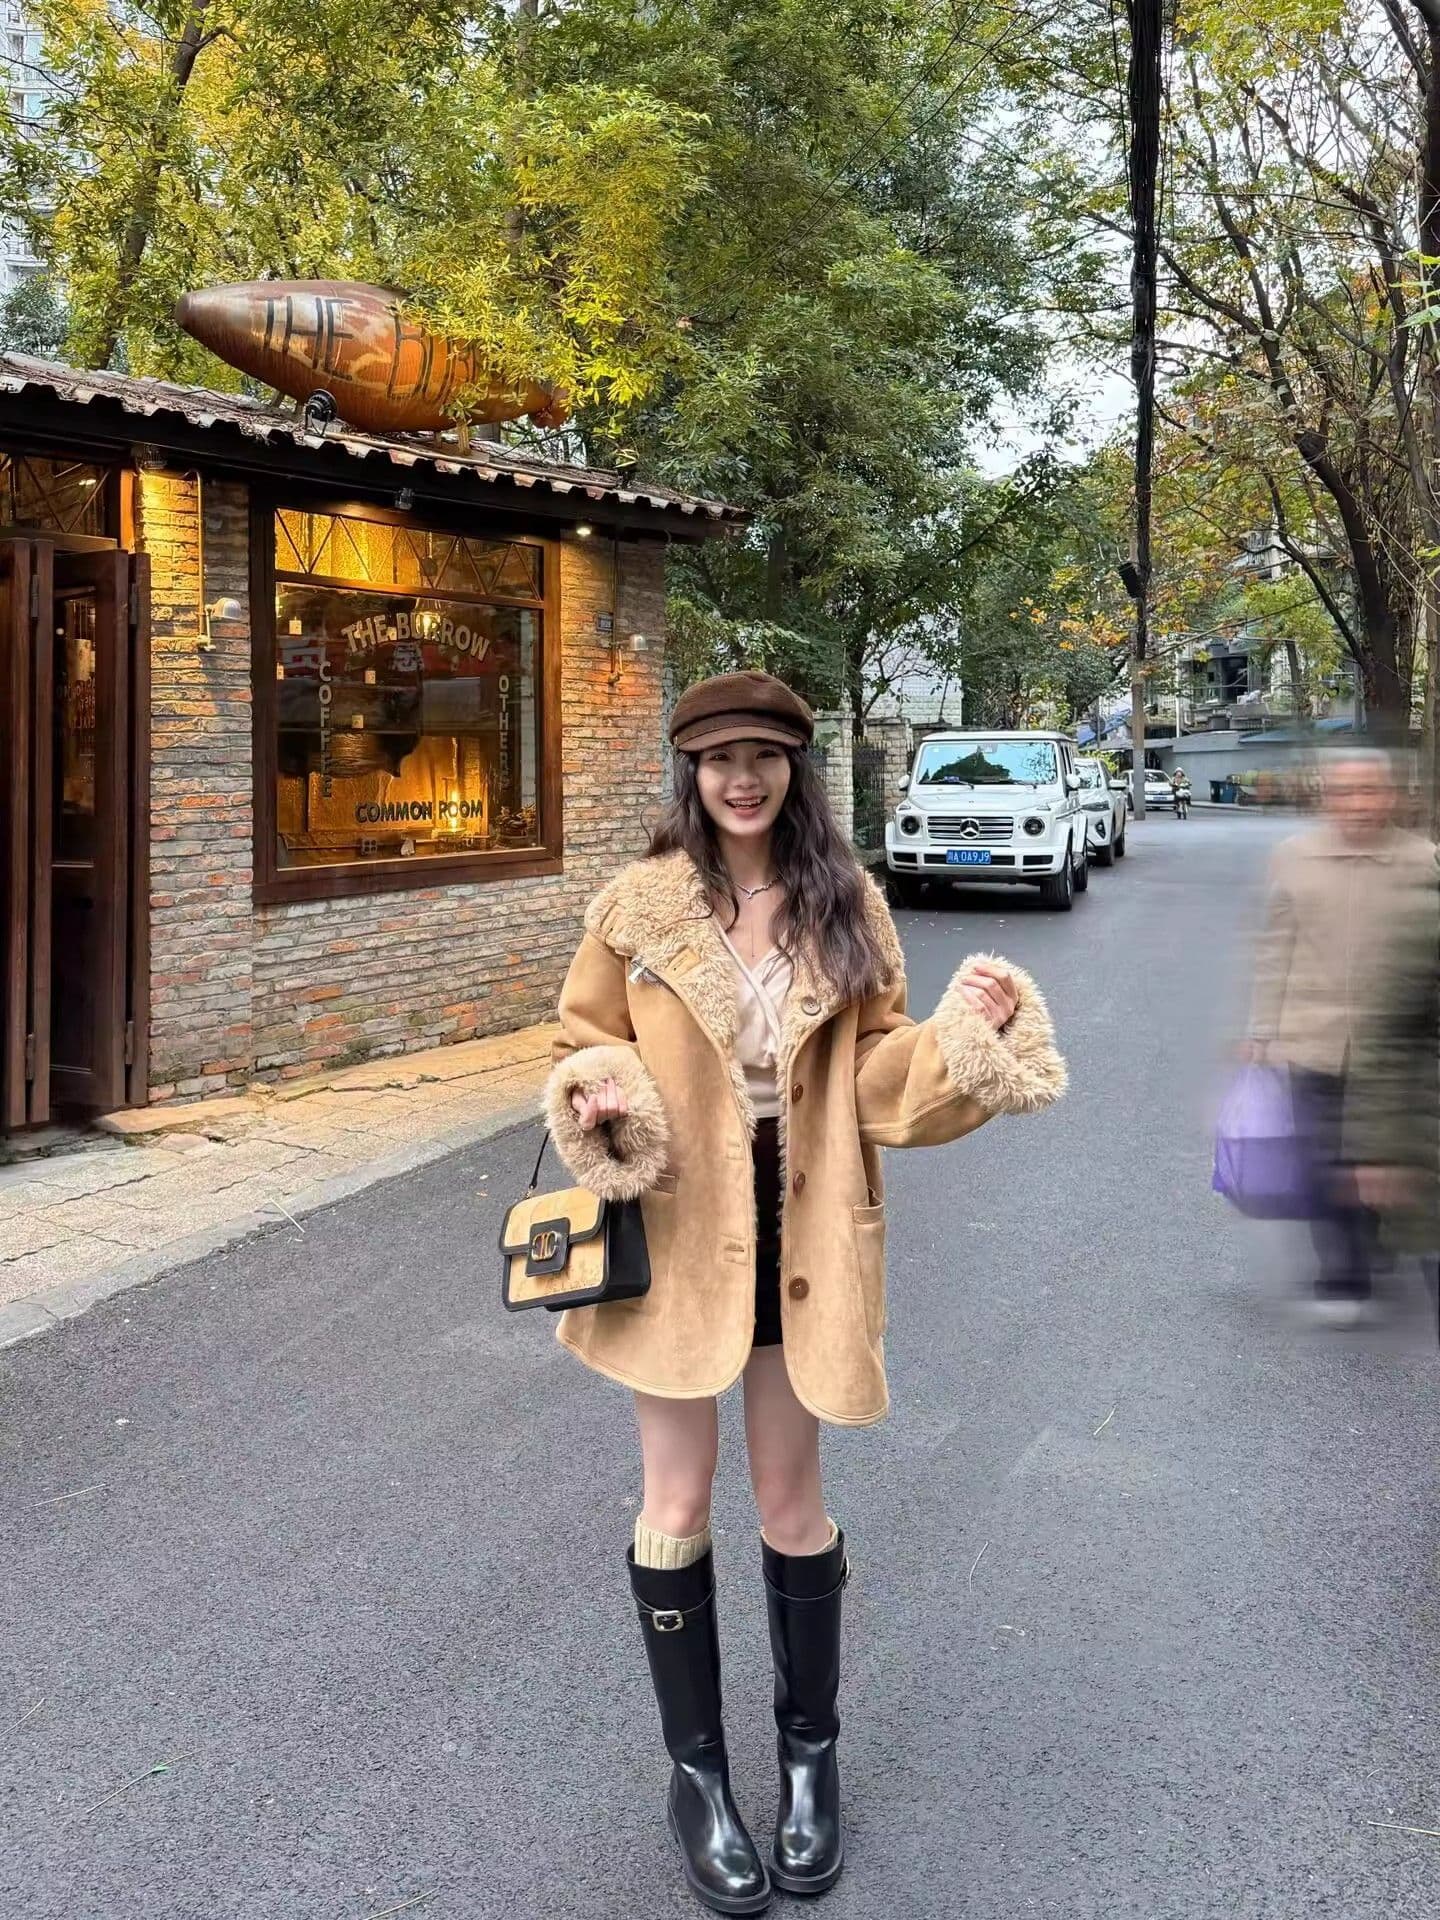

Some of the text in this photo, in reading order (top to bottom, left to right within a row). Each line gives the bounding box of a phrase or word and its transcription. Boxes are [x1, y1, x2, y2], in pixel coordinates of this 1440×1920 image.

[251, 294, 353, 381] THE
[341, 611, 490, 661] THE BURROW
[318, 660, 332, 798] COFFEE
[355, 799, 483, 823] COMMON ROOM
